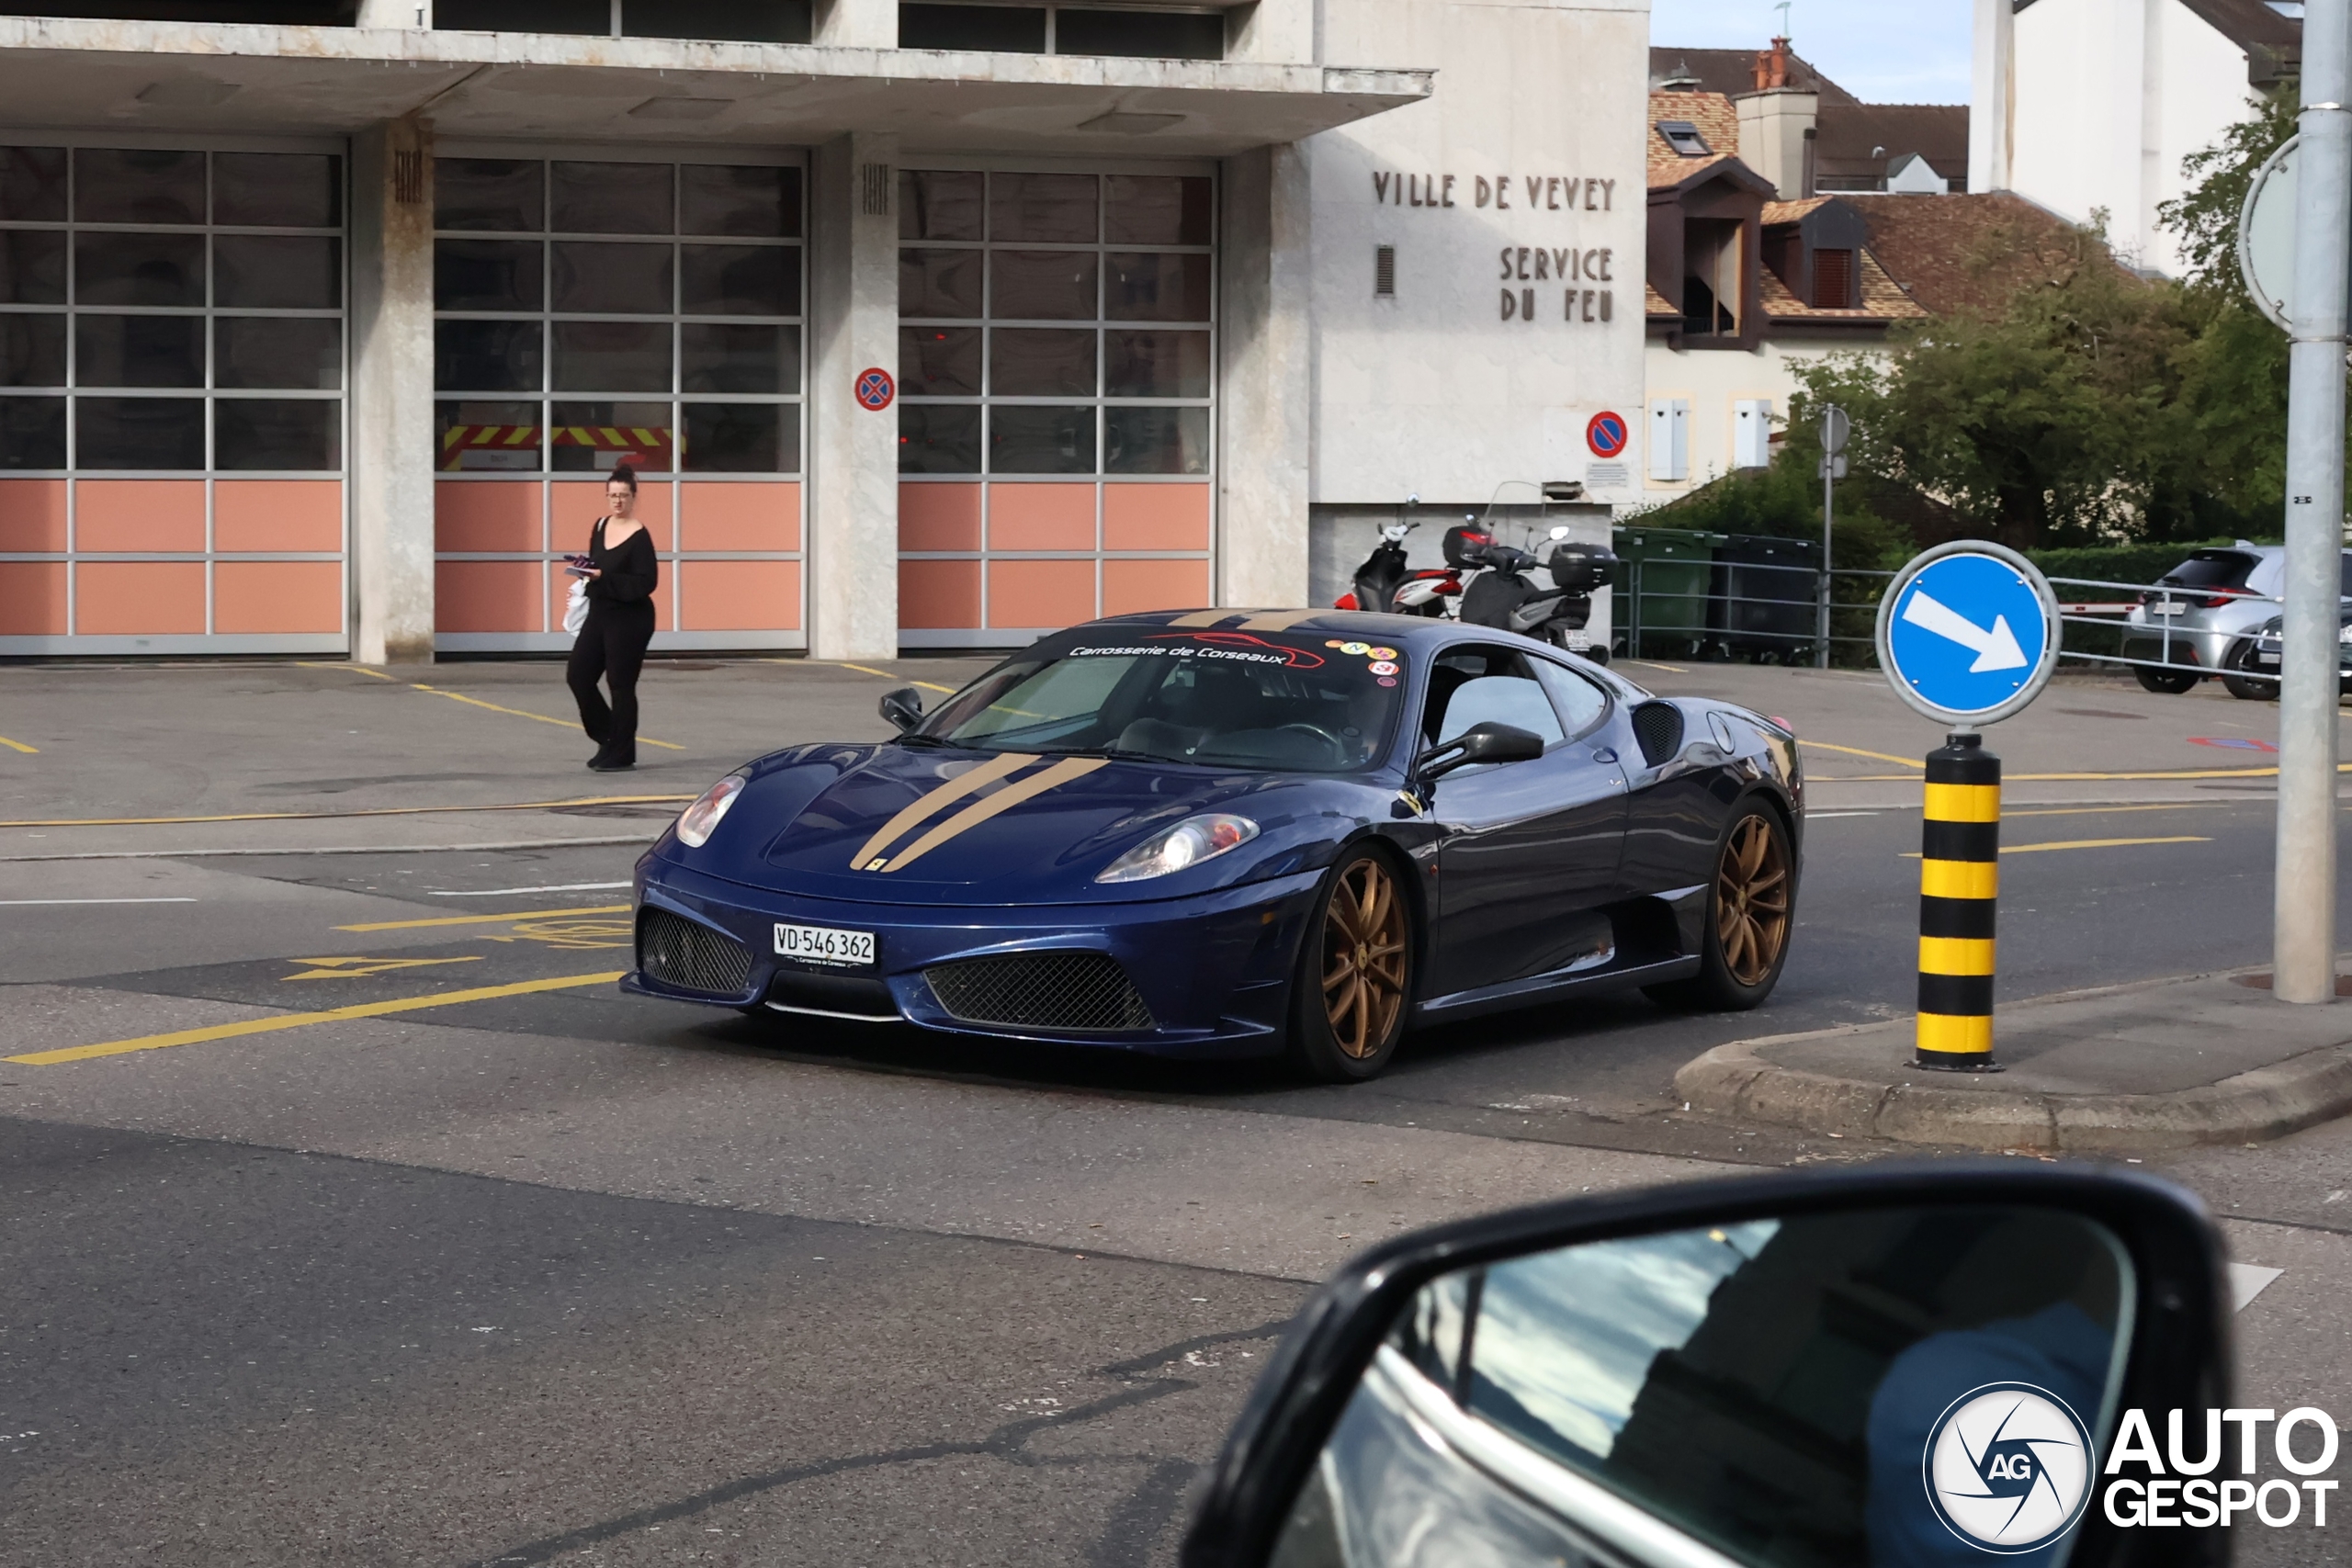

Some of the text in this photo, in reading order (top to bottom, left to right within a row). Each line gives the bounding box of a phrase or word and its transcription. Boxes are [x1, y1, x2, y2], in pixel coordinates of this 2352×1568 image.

[1374, 171, 1615, 210] VILLE DE VEVEY
[1499, 247, 1613, 281] SERVICE
[1501, 288, 1612, 322] DU FEU
[1069, 646, 1286, 664] Carrosserie de Corseaux
[839, 934, 872, 958] 362
